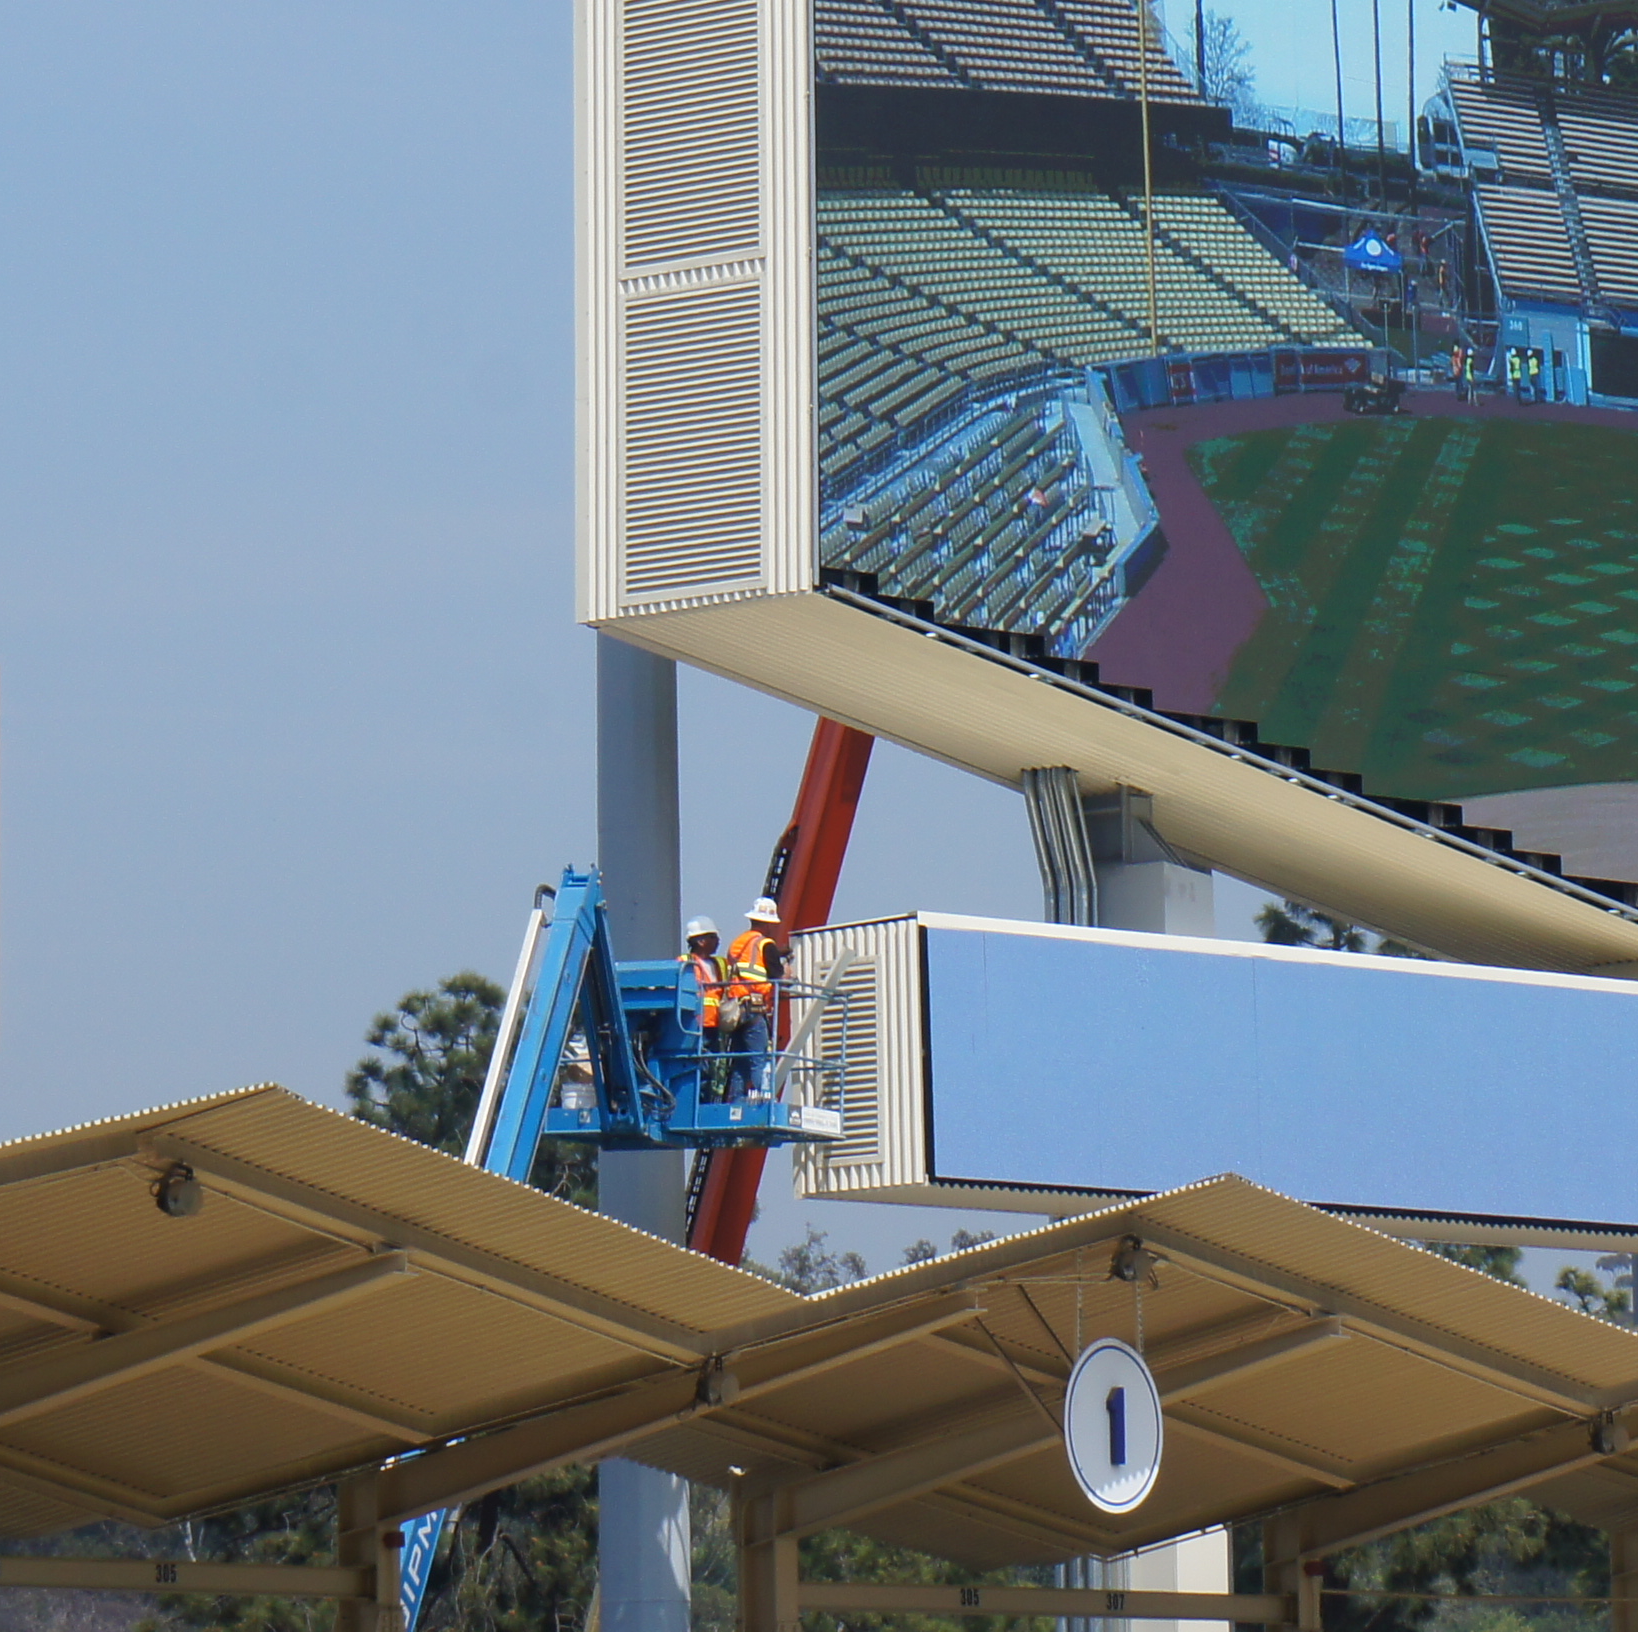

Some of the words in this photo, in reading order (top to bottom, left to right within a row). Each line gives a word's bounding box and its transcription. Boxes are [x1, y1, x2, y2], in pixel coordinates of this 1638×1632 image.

[1105, 1386, 1127, 1466] 1
[155, 1564, 178, 1584] 305
[960, 1587, 980, 1606] 305
[1105, 1592, 1125, 1611] 307
